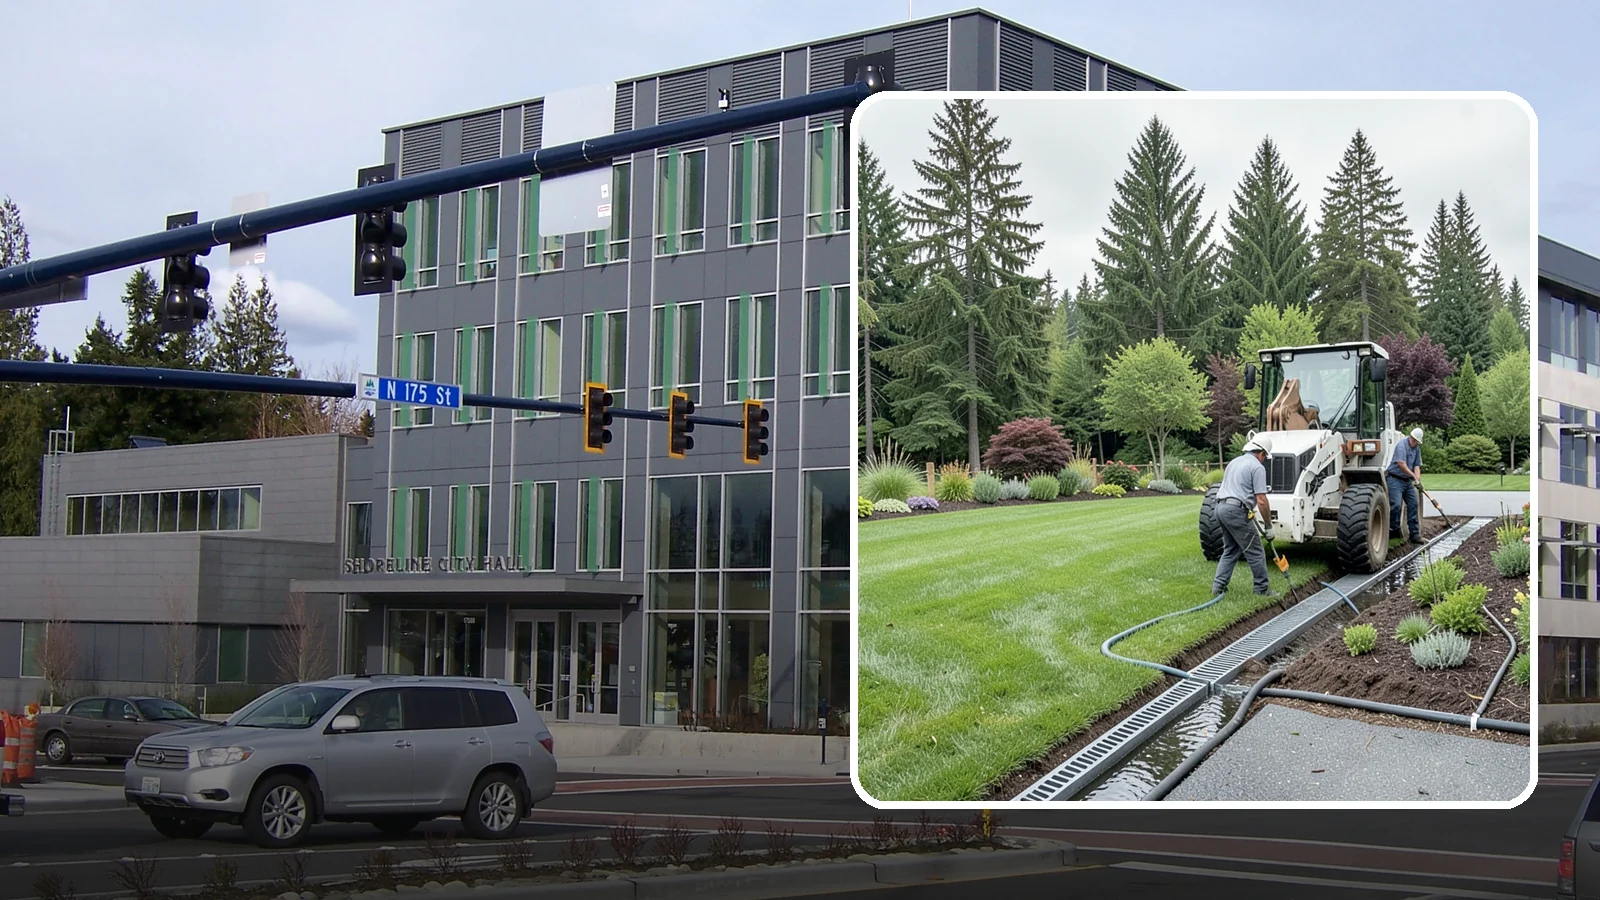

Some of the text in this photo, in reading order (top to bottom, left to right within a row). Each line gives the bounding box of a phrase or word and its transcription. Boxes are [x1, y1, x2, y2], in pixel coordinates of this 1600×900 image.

[387, 380, 451, 406] N 175 St
[344, 554, 525, 574] SHORELINE CITY HALL
